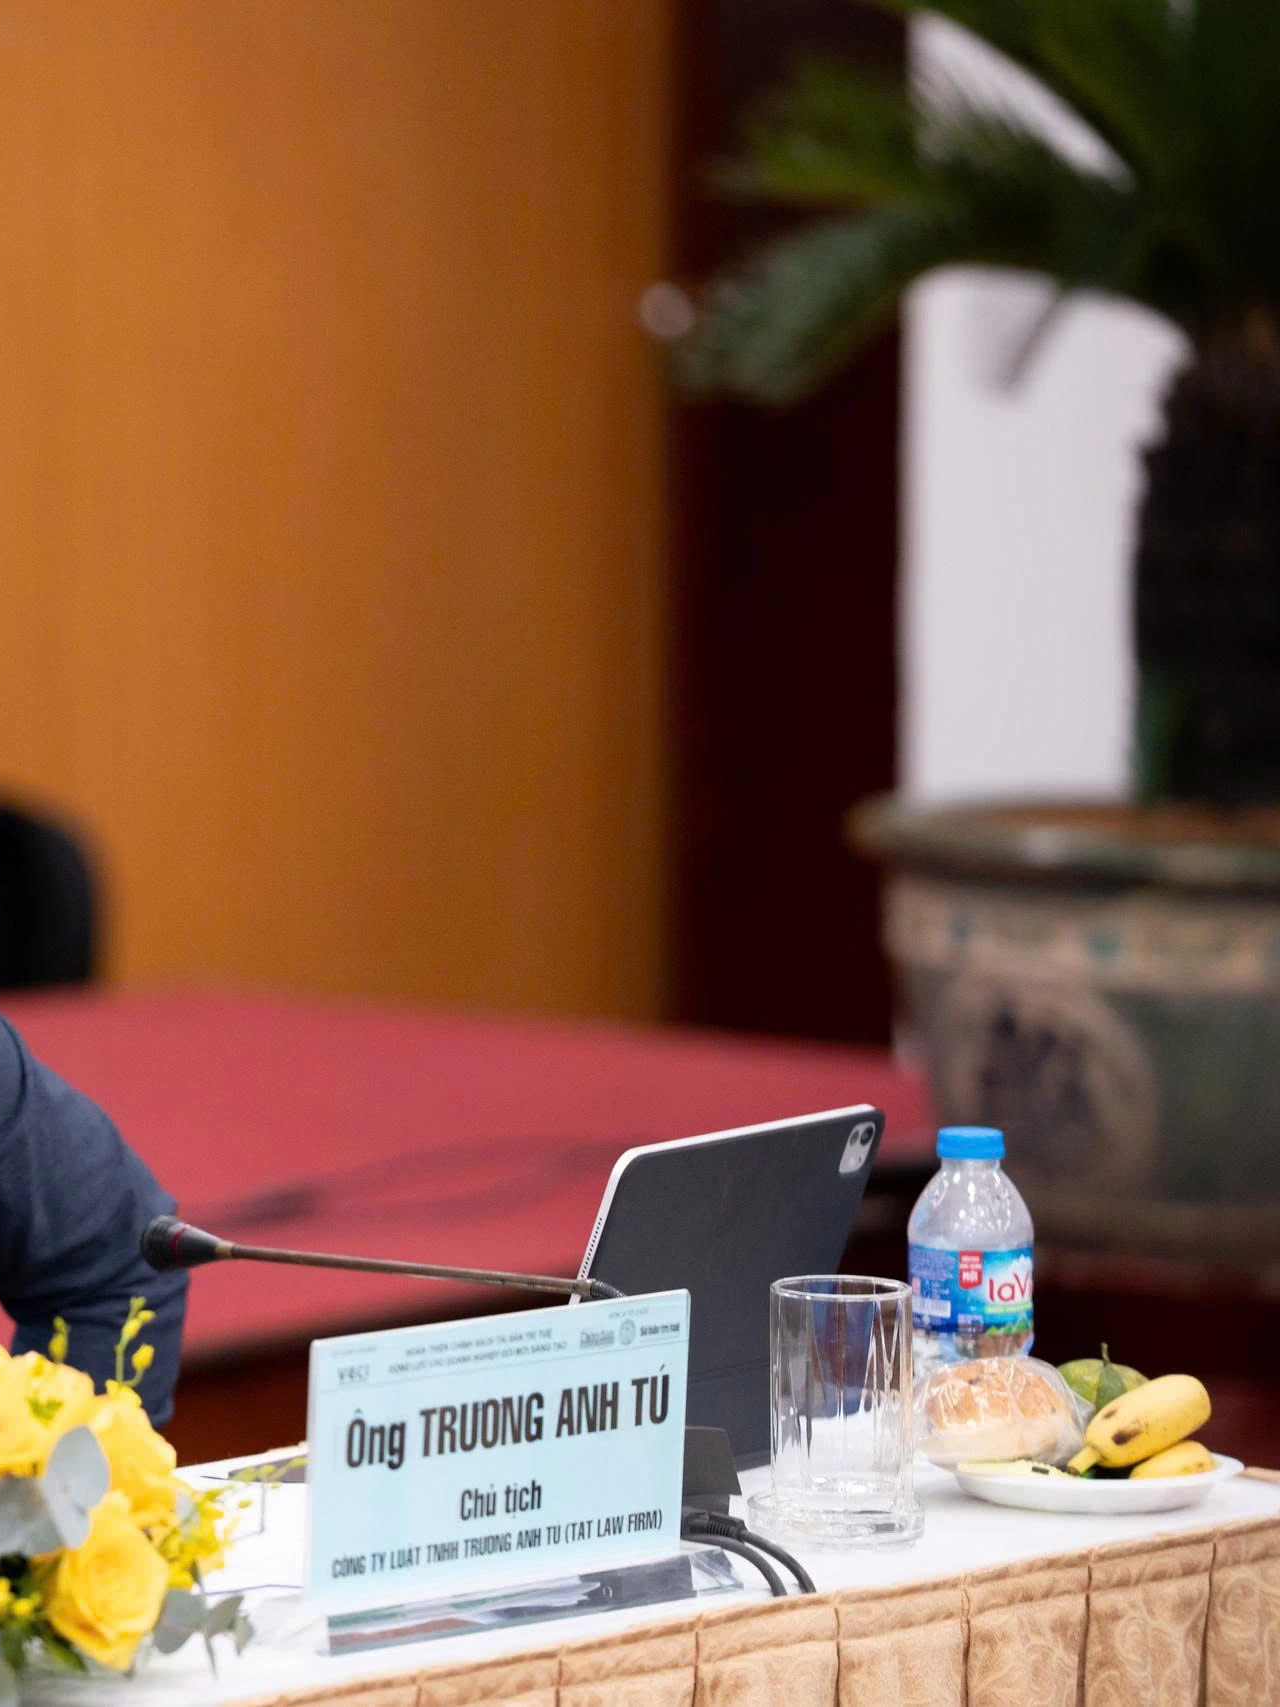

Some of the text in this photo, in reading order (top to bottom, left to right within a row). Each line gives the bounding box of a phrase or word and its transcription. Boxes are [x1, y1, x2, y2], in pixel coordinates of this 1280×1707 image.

[346, 1408, 406, 1470] Ông
[556, 1381, 619, 1438] ANH
[631, 1363, 669, 1426] TÚ
[460, 1479, 542, 1521] Chủ tịch
[371, 1551, 387, 1573] TY
[426, 1540, 459, 1564] TNHH
[516, 1528, 541, 1550] ANH
[565, 1519, 593, 1544] (TAT
[597, 1515, 624, 1538] LAW
[627, 1509, 663, 1533] FIRM)
